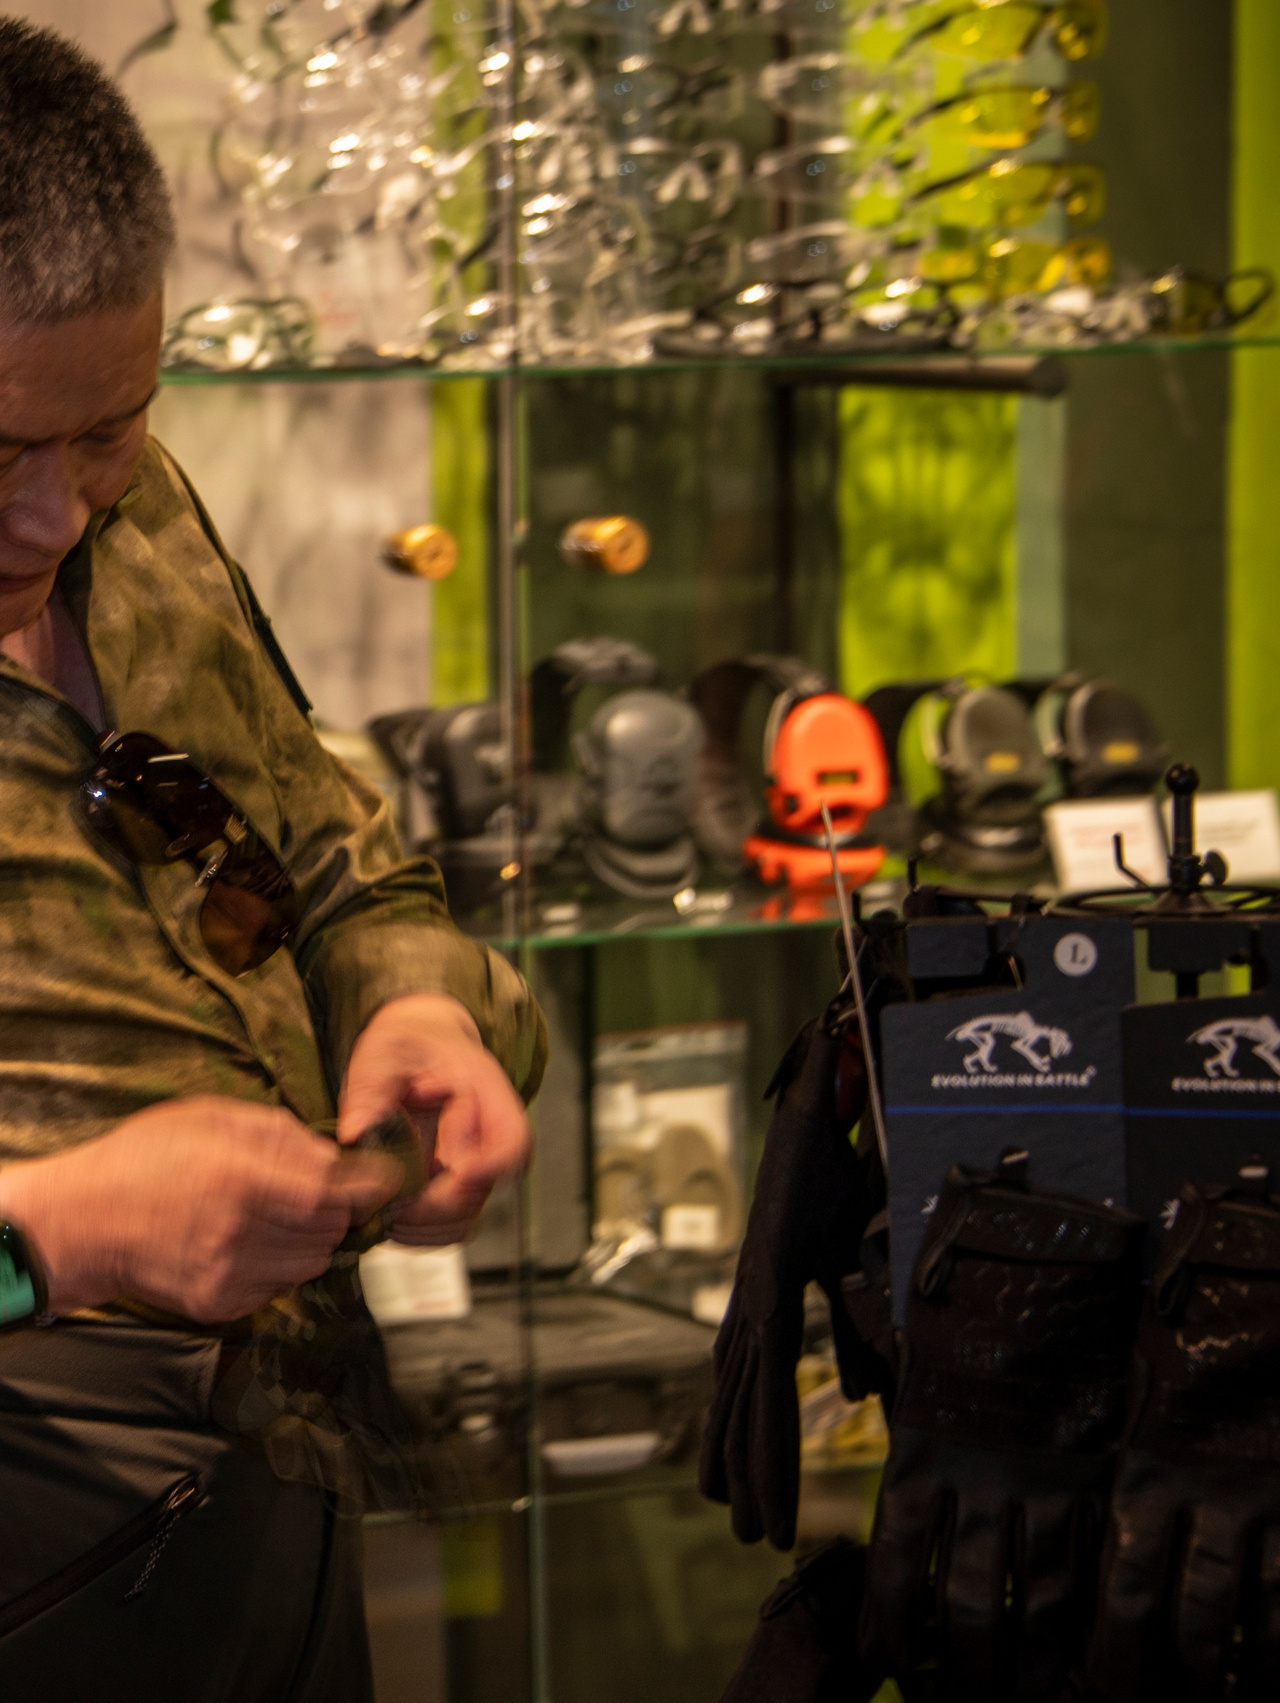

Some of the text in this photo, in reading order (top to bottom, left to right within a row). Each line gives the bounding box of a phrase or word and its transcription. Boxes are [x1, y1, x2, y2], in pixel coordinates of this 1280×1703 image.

[1070, 943, 1088, 965] L
[931, 1073, 1090, 1088] EVOLUTION IN BATTLE
[1171, 1077, 1257, 1093] EVOLUTION
